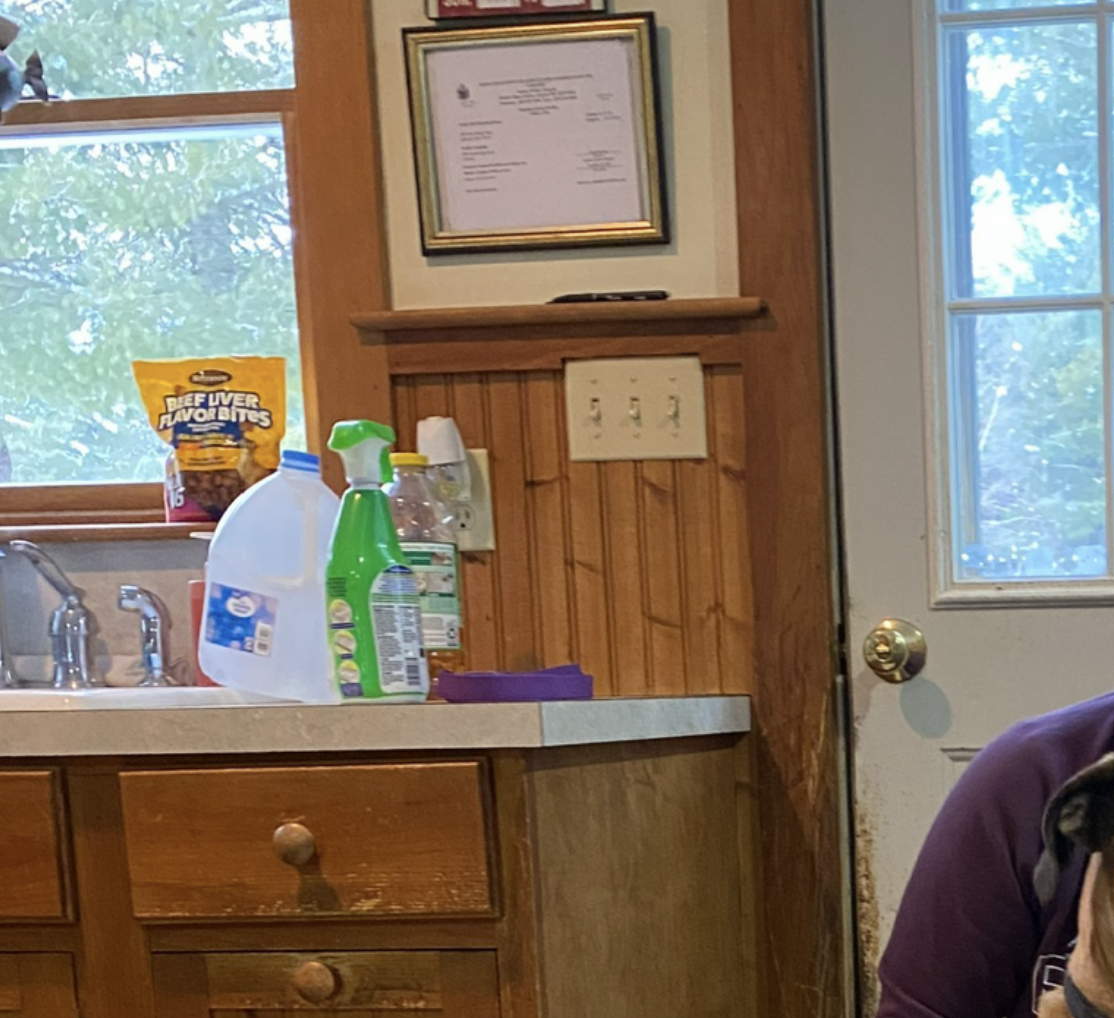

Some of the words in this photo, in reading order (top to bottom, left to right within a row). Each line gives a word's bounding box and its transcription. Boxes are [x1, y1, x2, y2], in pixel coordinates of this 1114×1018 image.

[165, 392, 206, 412] BEEF
[208, 392, 259, 408] LIVER
[159, 407, 217, 430] FLAVOR
